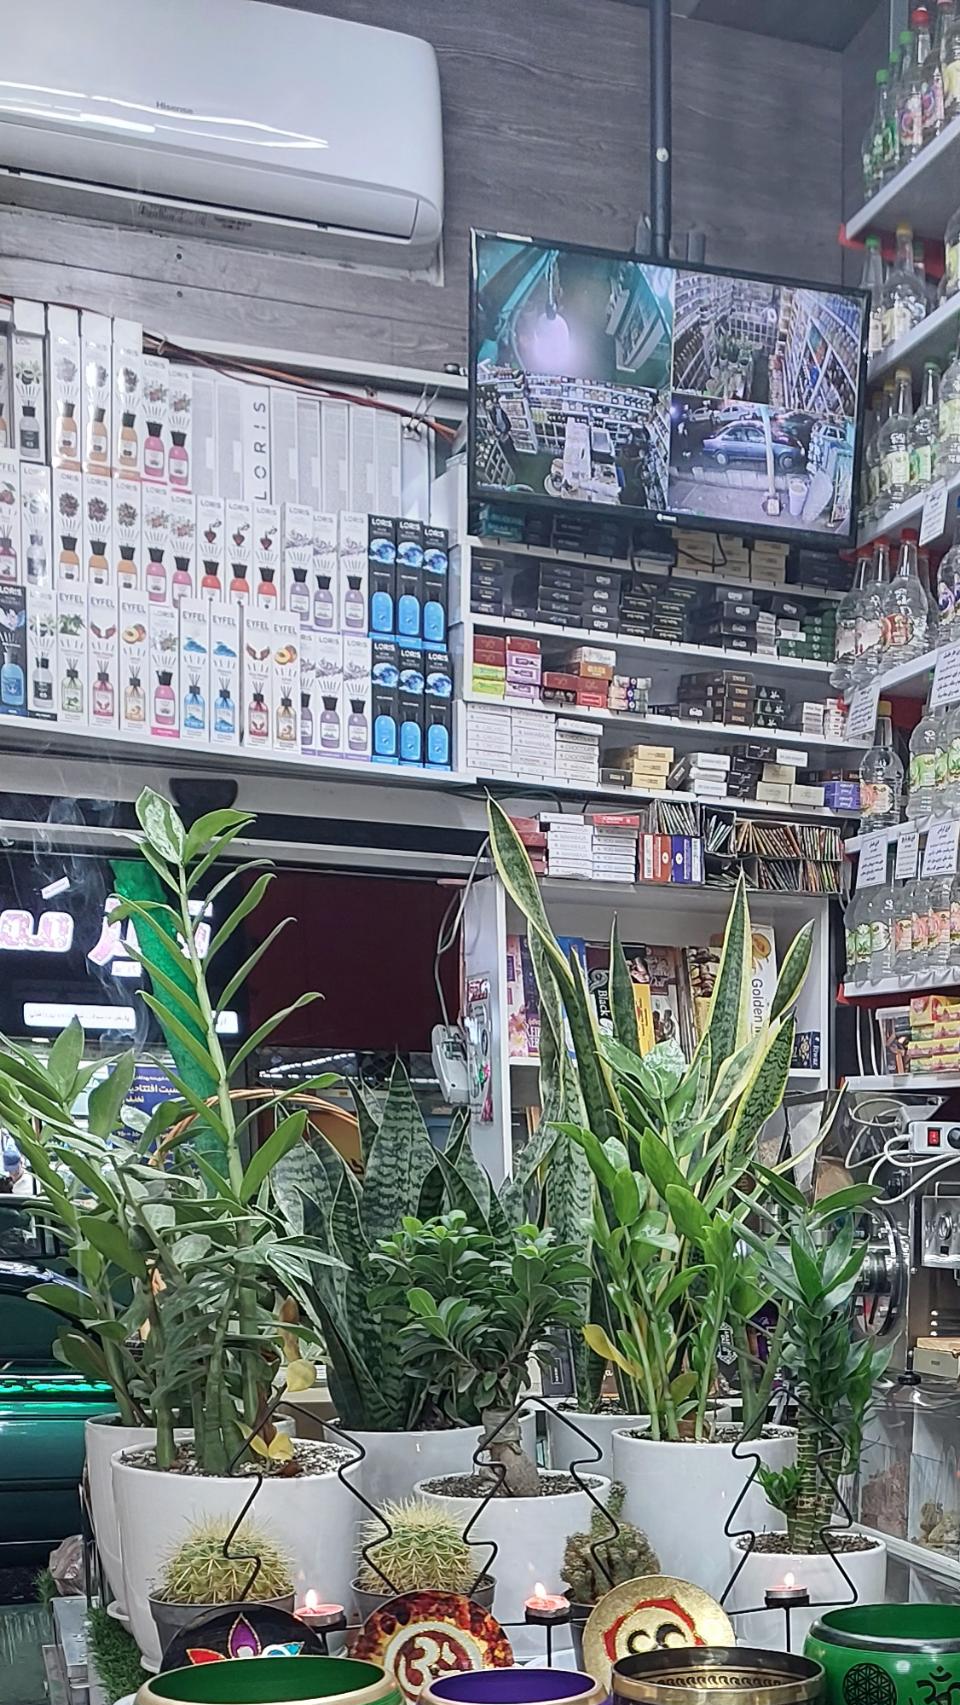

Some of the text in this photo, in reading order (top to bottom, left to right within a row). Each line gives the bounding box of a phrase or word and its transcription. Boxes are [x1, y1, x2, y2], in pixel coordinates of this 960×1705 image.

[156, 101, 193, 115] Hisense
[371, 518, 393, 528] LORIS
[399, 521, 421, 531] LORIS
[424, 528, 445, 538] LORIS
[0, 586, 22, 597] LORIS
[59, 593, 84, 604] EYFEL
[90, 597, 116, 609] EYFEL
[122, 603, 147, 615] EYFEL
[182, 612, 207, 624] EYFEL
[212, 615, 237, 627] EYFEL
[246, 619, 270, 631] EYFEL
[273, 623, 297, 635] EYFEL
[374, 642, 395, 652] LORIS
[400, 649, 421, 659] LORIS
[428, 652, 449, 662] LORIS
[597, 989, 611, 1017] Black
[751, 978, 765, 1023] Golden
